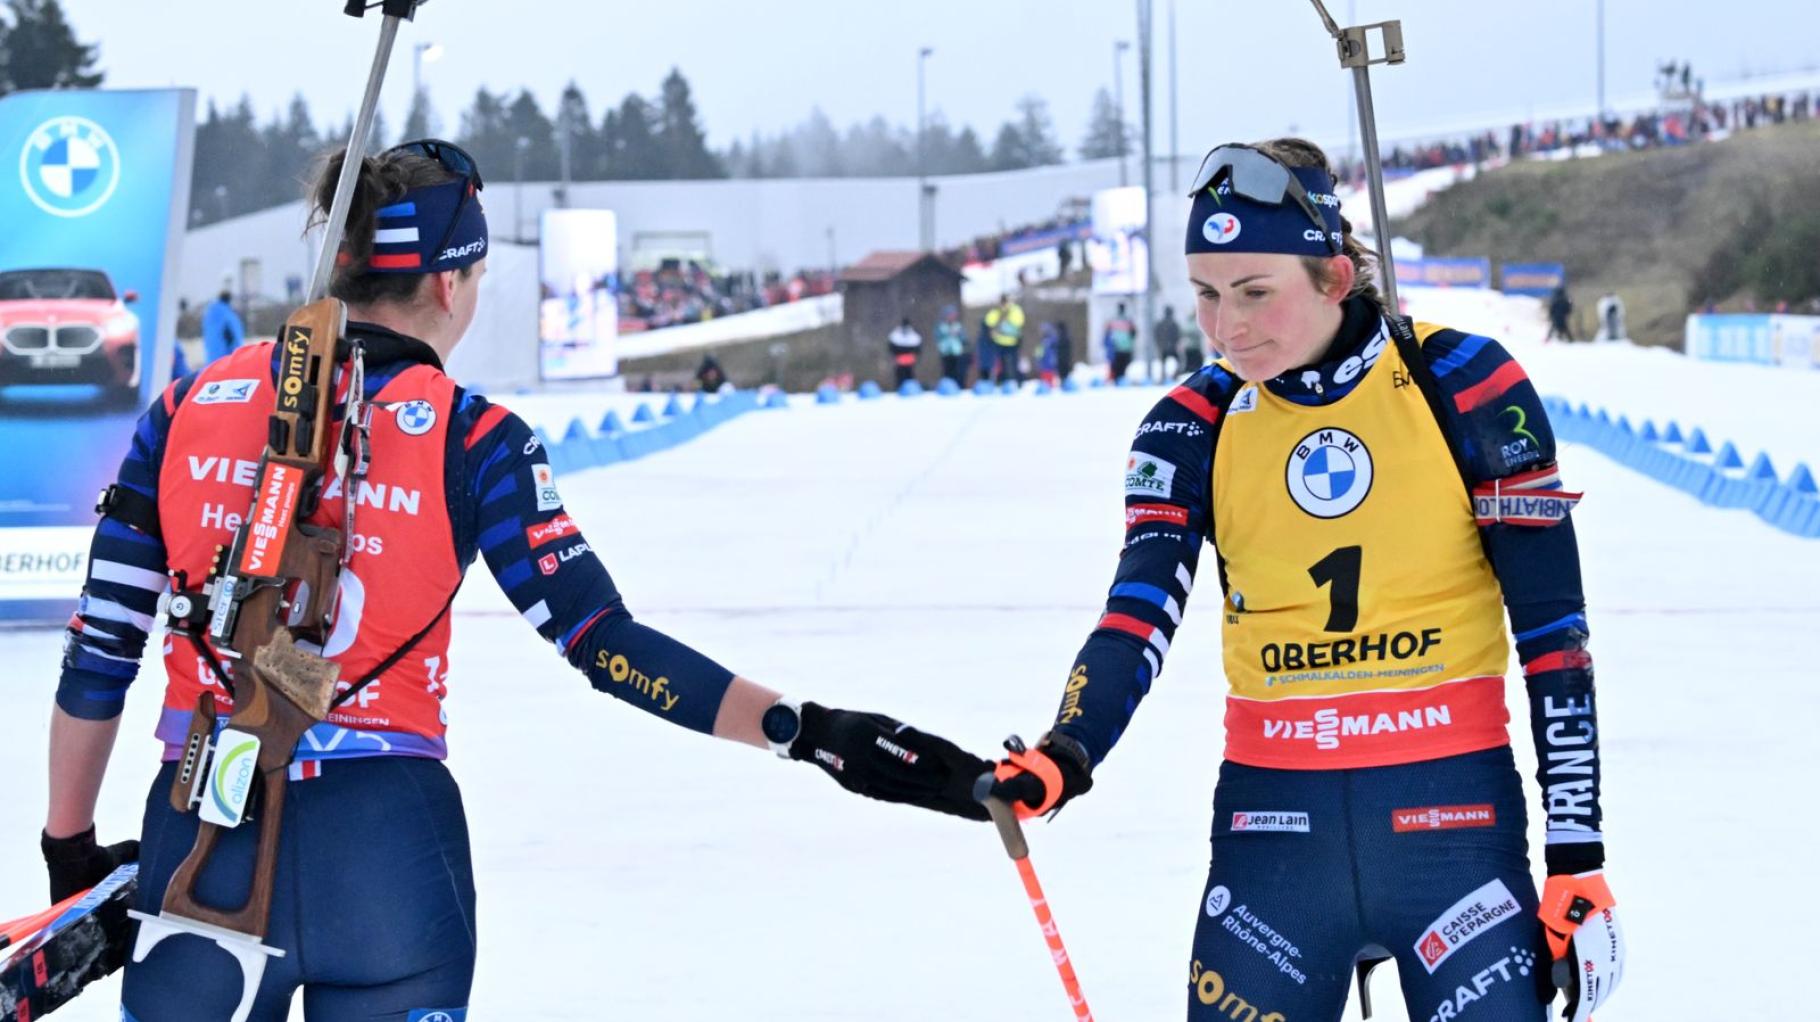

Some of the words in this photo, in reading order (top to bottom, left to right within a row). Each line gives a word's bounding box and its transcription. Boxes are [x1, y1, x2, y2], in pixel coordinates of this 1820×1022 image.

[283, 330, 310, 408] somfy
[1296, 431, 1359, 460] BMW
[1501, 438, 1528, 459] ROY
[248, 466, 287, 570] VIESSMANN
[1307, 545, 1363, 633] 1
[1261, 628, 1442, 673] OBERHOF
[595, 649, 680, 711] somfy
[1263, 704, 1452, 750] VIESSMANN
[1248, 815, 1277, 825] Jean
[1398, 808, 1490, 827] VIESSMANN
[1232, 904, 1303, 959] Auvergne-
[1442, 902, 1487, 936] CAISSE
[1448, 899, 1516, 945] D'EPARGNE
[1221, 915, 1307, 985] Rhône-Alpes
